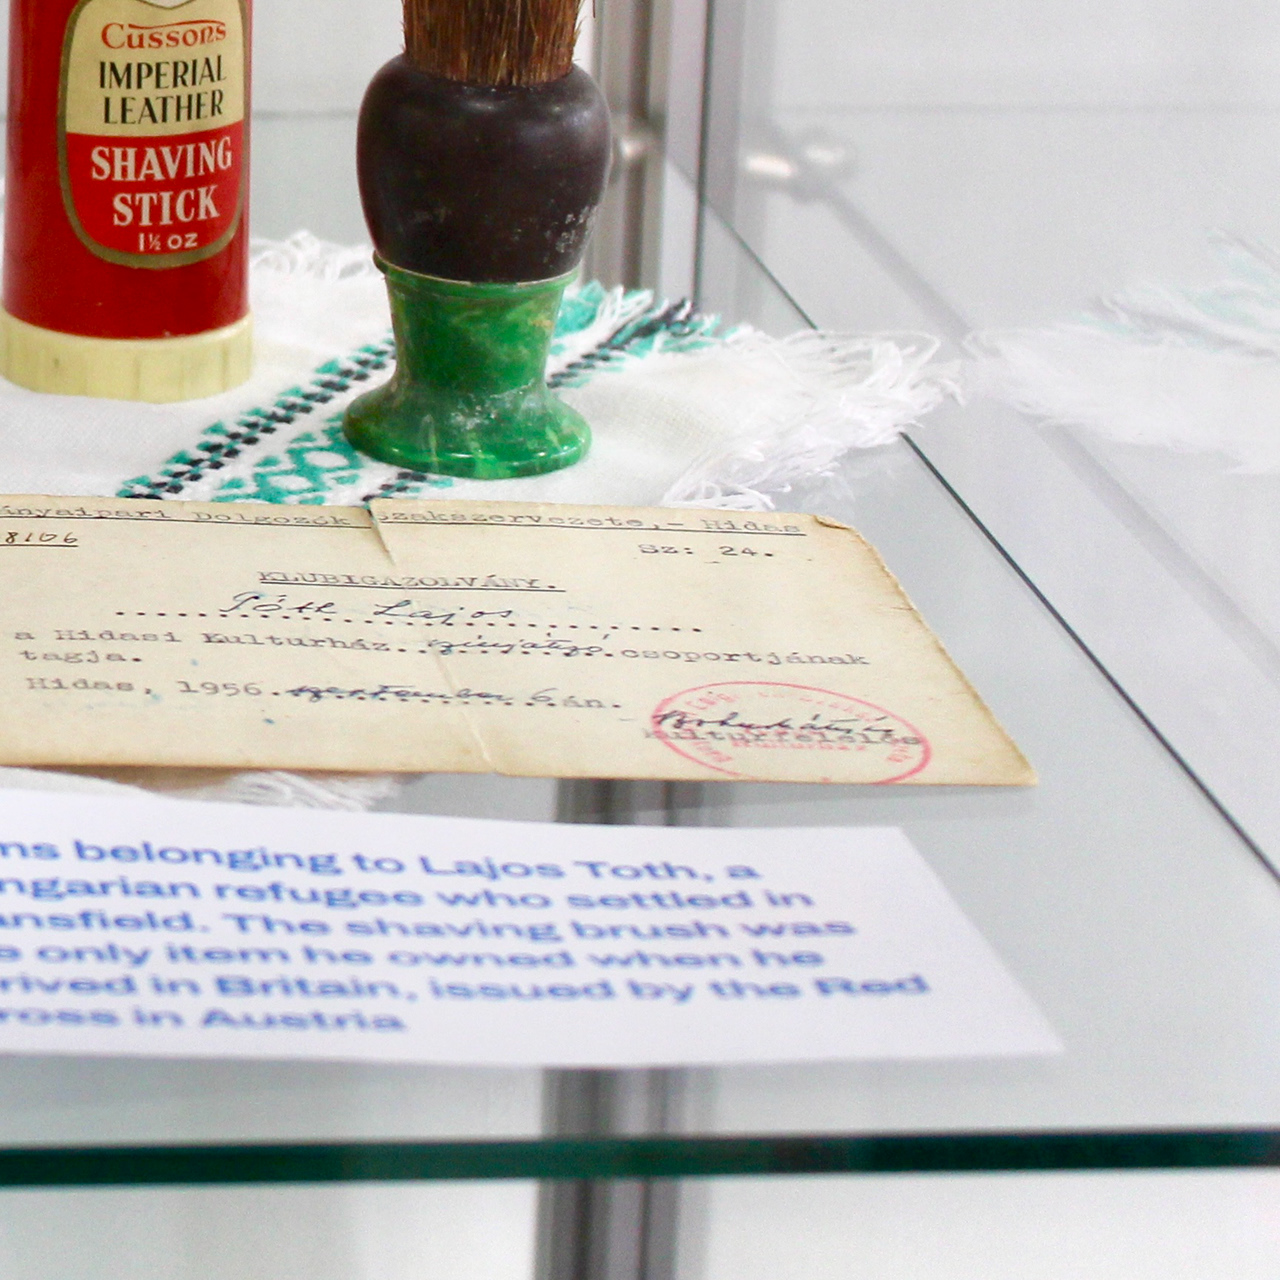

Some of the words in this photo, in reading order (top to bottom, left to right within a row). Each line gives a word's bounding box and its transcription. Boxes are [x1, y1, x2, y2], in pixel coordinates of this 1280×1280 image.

[101, 19, 227, 50] Cussons
[98, 54, 227, 90] IMPERIAL
[103, 89, 224, 125] LEATHER
[91, 136, 232, 182] SHAVING
[112, 185, 221, 227] STICK
[74, 840, 342, 875] belonging
[355, 850, 405, 875] to
[419, 856, 566, 881] Lajos
[574, 860, 714, 882] Toth,
[726, 863, 762, 881] a
[214, 881, 424, 908] refugee
[437, 890, 553, 909] who
[567, 890, 752, 909] settled
[764, 890, 815, 909] in
[222, 912, 331, 936] The
[345, 917, 563, 943] shaving
[575, 919, 730, 939] brush
[741, 920, 857, 938] was
[37, 943, 151, 968] only
[164, 942, 291, 965] item
[302, 945, 374, 967] he
[387, 949, 574, 969] owned
[590, 949, 742, 968] when
[752, 949, 826, 968] he
[150, 973, 201, 997] in
[214, 976, 418, 1001] Britain,
[429, 978, 616, 1000] issued
[626, 978, 694, 1004] by
[708, 977, 801, 998] the
[814, 974, 931, 996] Red
[136, 1007, 186, 1029] in
[199, 1007, 407, 1033] Austria
